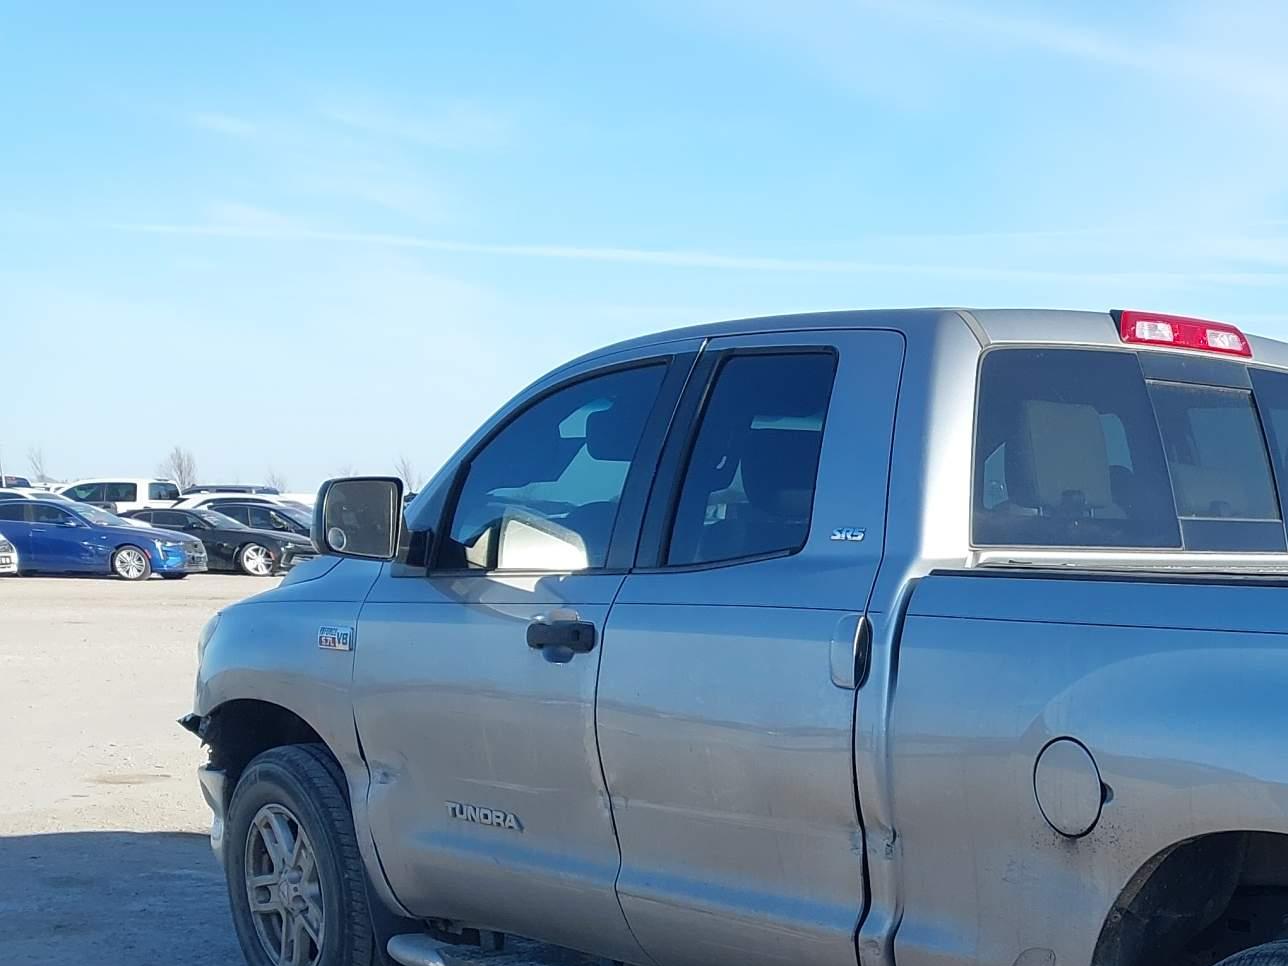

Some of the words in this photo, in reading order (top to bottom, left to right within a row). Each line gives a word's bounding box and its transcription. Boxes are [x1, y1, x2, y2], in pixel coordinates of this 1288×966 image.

[830, 527, 866, 542] SR5
[336, 631, 349, 646] V8
[444, 800, 524, 832] TUNDRA
